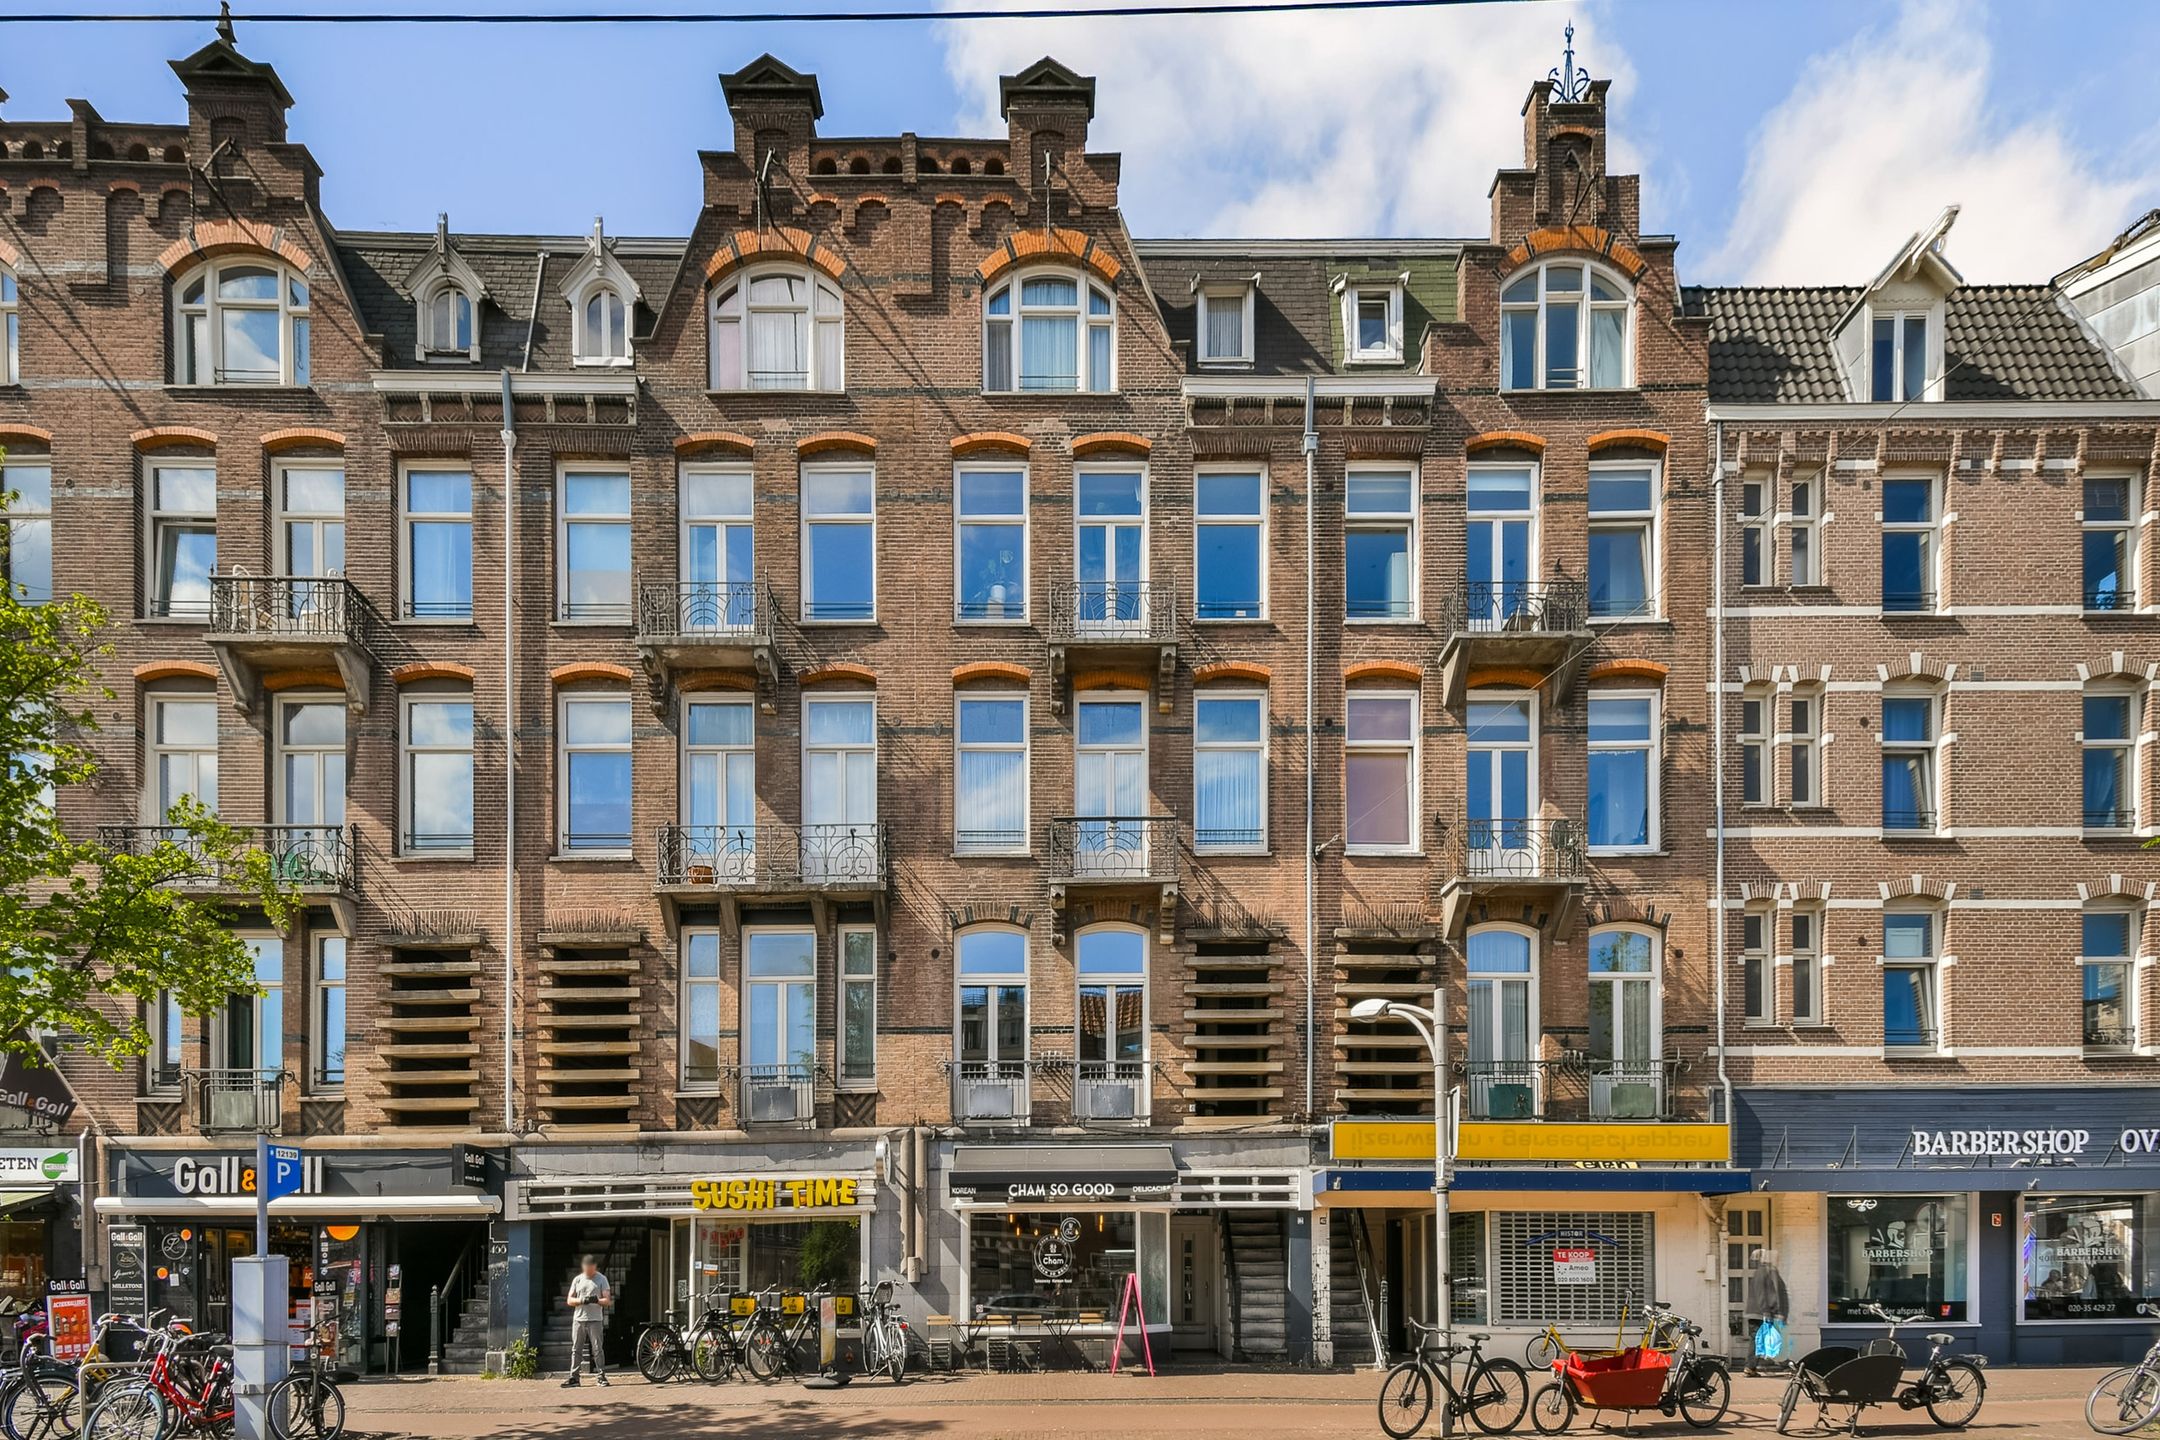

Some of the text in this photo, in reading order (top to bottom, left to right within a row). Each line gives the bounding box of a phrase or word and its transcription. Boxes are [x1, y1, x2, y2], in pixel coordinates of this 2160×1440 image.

[35, 1096, 69, 1116] Gall
[1912, 1129, 2090, 1156] BARBERSHOP
[277, 1150, 298, 1160] 12139
[174, 1156, 240, 1194] Gall
[241, 1168, 257, 1192] &
[276, 1162, 291, 1184] P
[952, 1186, 977, 1195] KOREAN
[1008, 1183, 1046, 1197] CHAM
[1049, 1183, 1069, 1197] SO
[1072, 1183, 1116, 1197] GOOD
[1557, 1251, 1590, 1259] TE KOOP
[1862, 1248, 1934, 1258] BARBERSHOP
[1042, 1256, 1064, 1265] Cham
[50, 1280, 66, 1291] Gall
[70, 1279, 86, 1290] Gall
[1896, 1307, 1926, 1316] afspraak
[2068, 1304, 2116, 1312] 020-35 429 27
